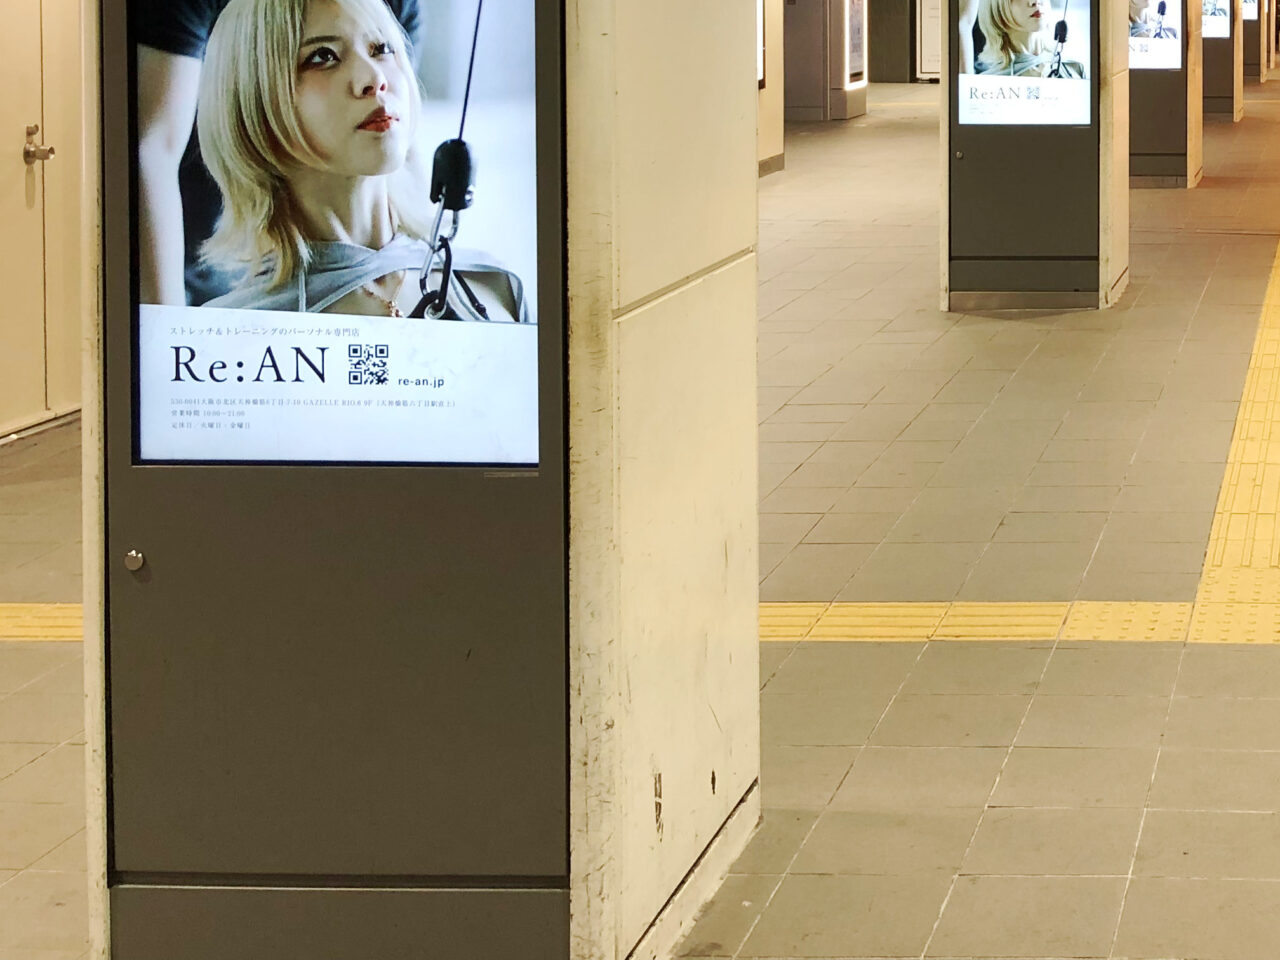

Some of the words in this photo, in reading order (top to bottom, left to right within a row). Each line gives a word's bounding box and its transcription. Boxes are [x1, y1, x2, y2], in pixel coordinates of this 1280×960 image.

[969, 86, 1021, 100] Re:AN
[170, 344, 330, 383] Re:AN
[398, 377, 445, 388] re-an.jp
